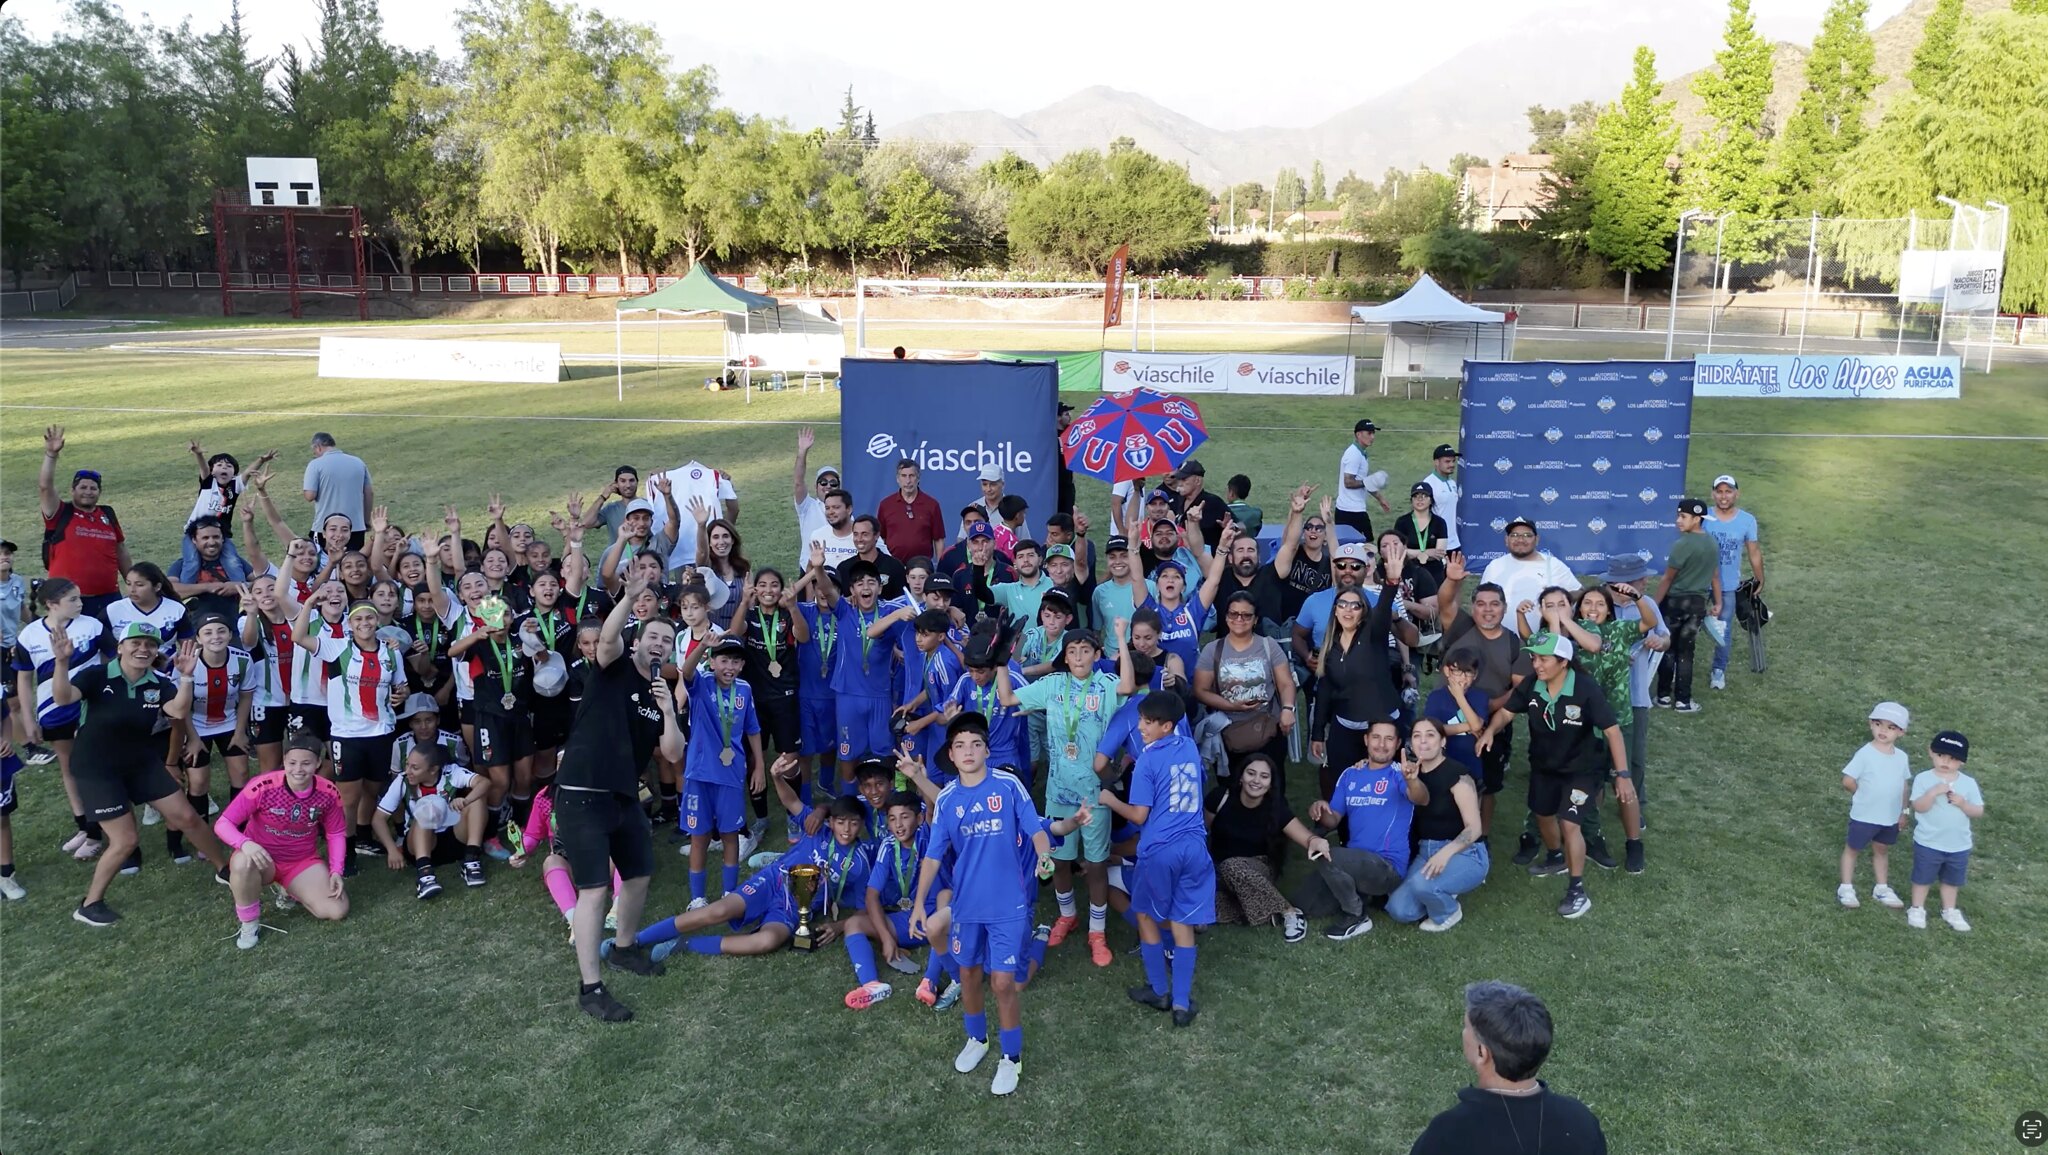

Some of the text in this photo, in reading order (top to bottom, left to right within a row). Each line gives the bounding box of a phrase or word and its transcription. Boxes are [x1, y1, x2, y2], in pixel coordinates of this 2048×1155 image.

[1985, 269, 1996, 281] 20
[1984, 281, 1995, 293] 25
[1133, 365, 1215, 383] víaschile
[1258, 366, 1340, 385] víaschile
[1698, 359, 1778, 385] HIDRÁTATE
[1788, 357, 1898, 397] Los Alpes
[1904, 366, 1954, 380] AGUA
[1760, 383, 1781, 394] CON
[1903, 379, 1954, 389] PURIFICADA
[1154, 417, 1193, 455] U
[900, 441, 1032, 473] víaschile
[1082, 436, 1118, 473] U
[1175, 613, 1188, 626] U
[734, 696, 745, 709] U
[1086, 694, 1100, 711] U
[332, 741, 342, 760] 9
[1374, 778, 1389, 794] U
[987, 795, 1003, 813] U
